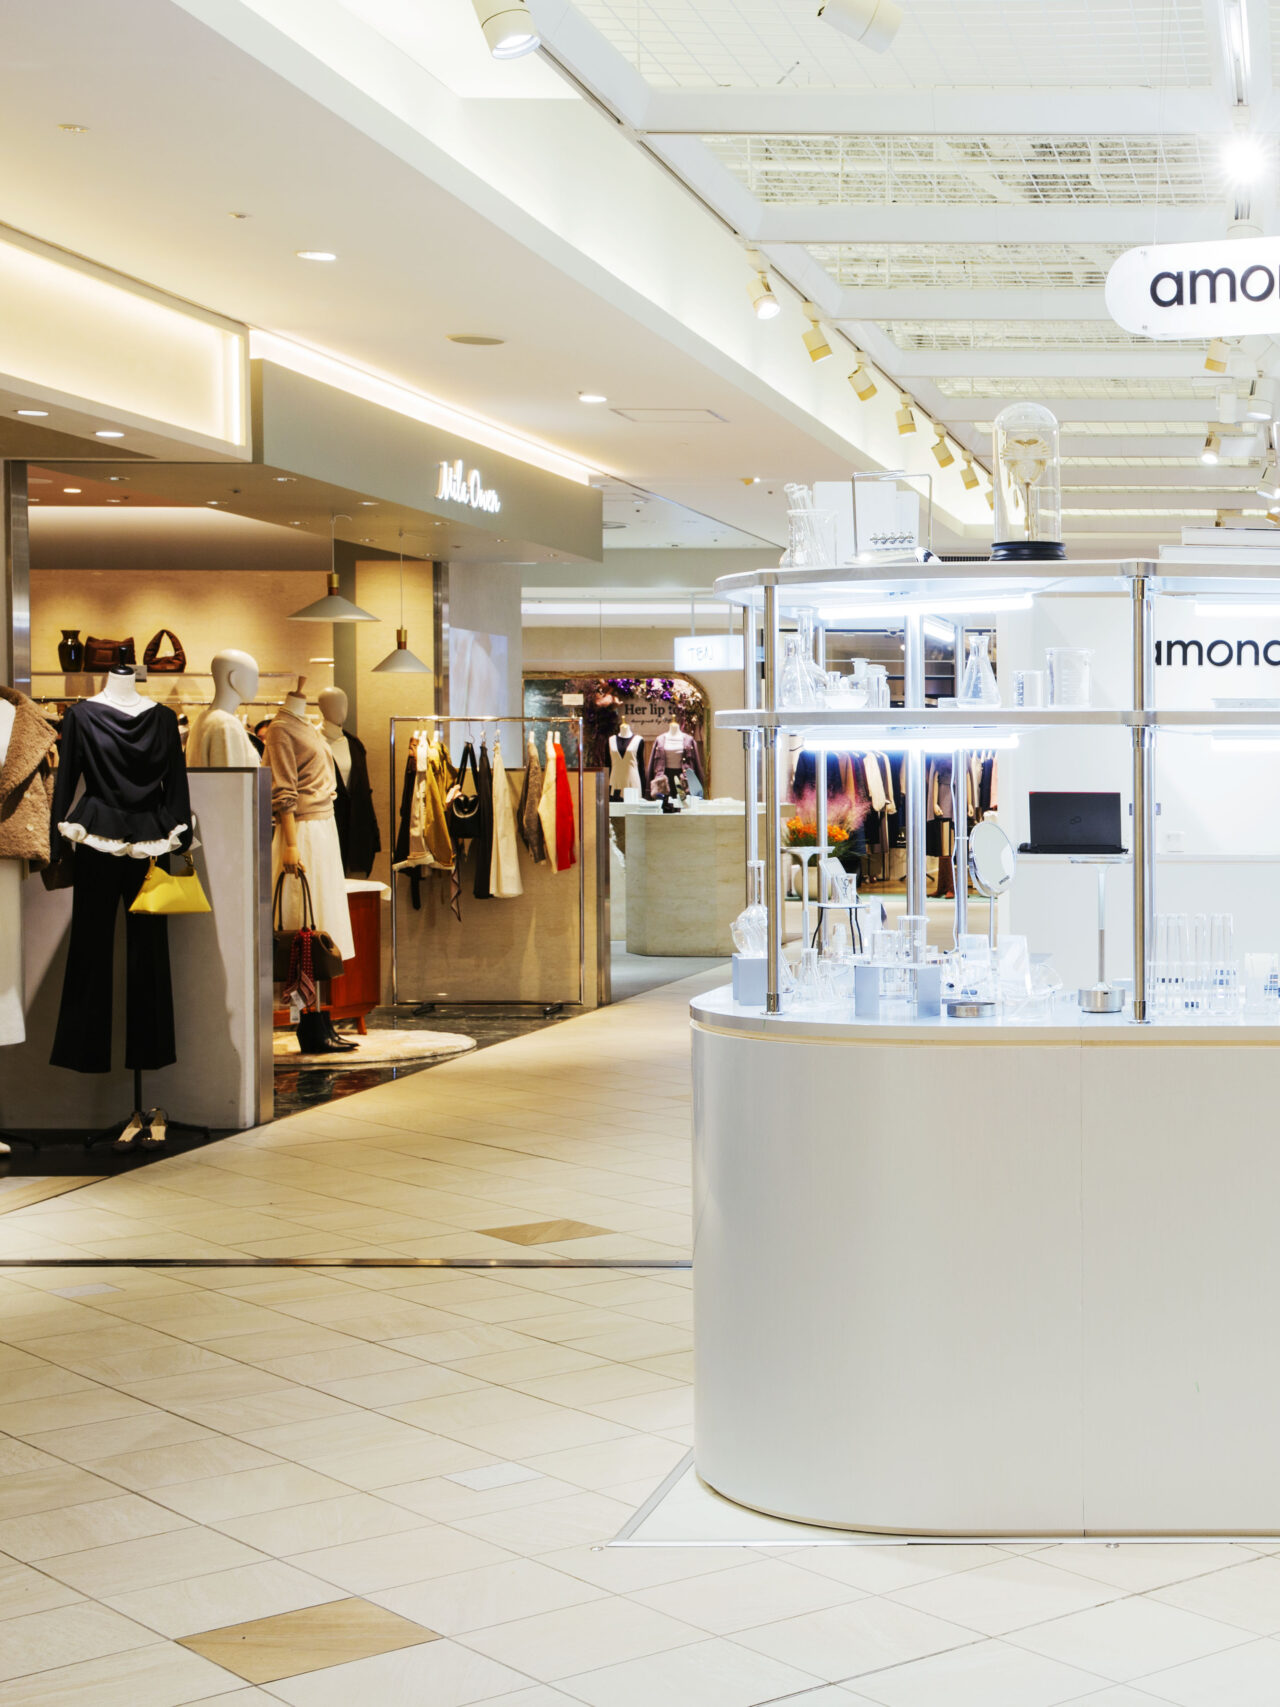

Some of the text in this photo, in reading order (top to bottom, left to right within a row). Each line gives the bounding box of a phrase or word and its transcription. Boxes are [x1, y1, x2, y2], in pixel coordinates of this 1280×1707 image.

[435, 459, 469, 504] Mila
[624, 703, 648, 715] Her
[649, 703, 665, 717] lip
